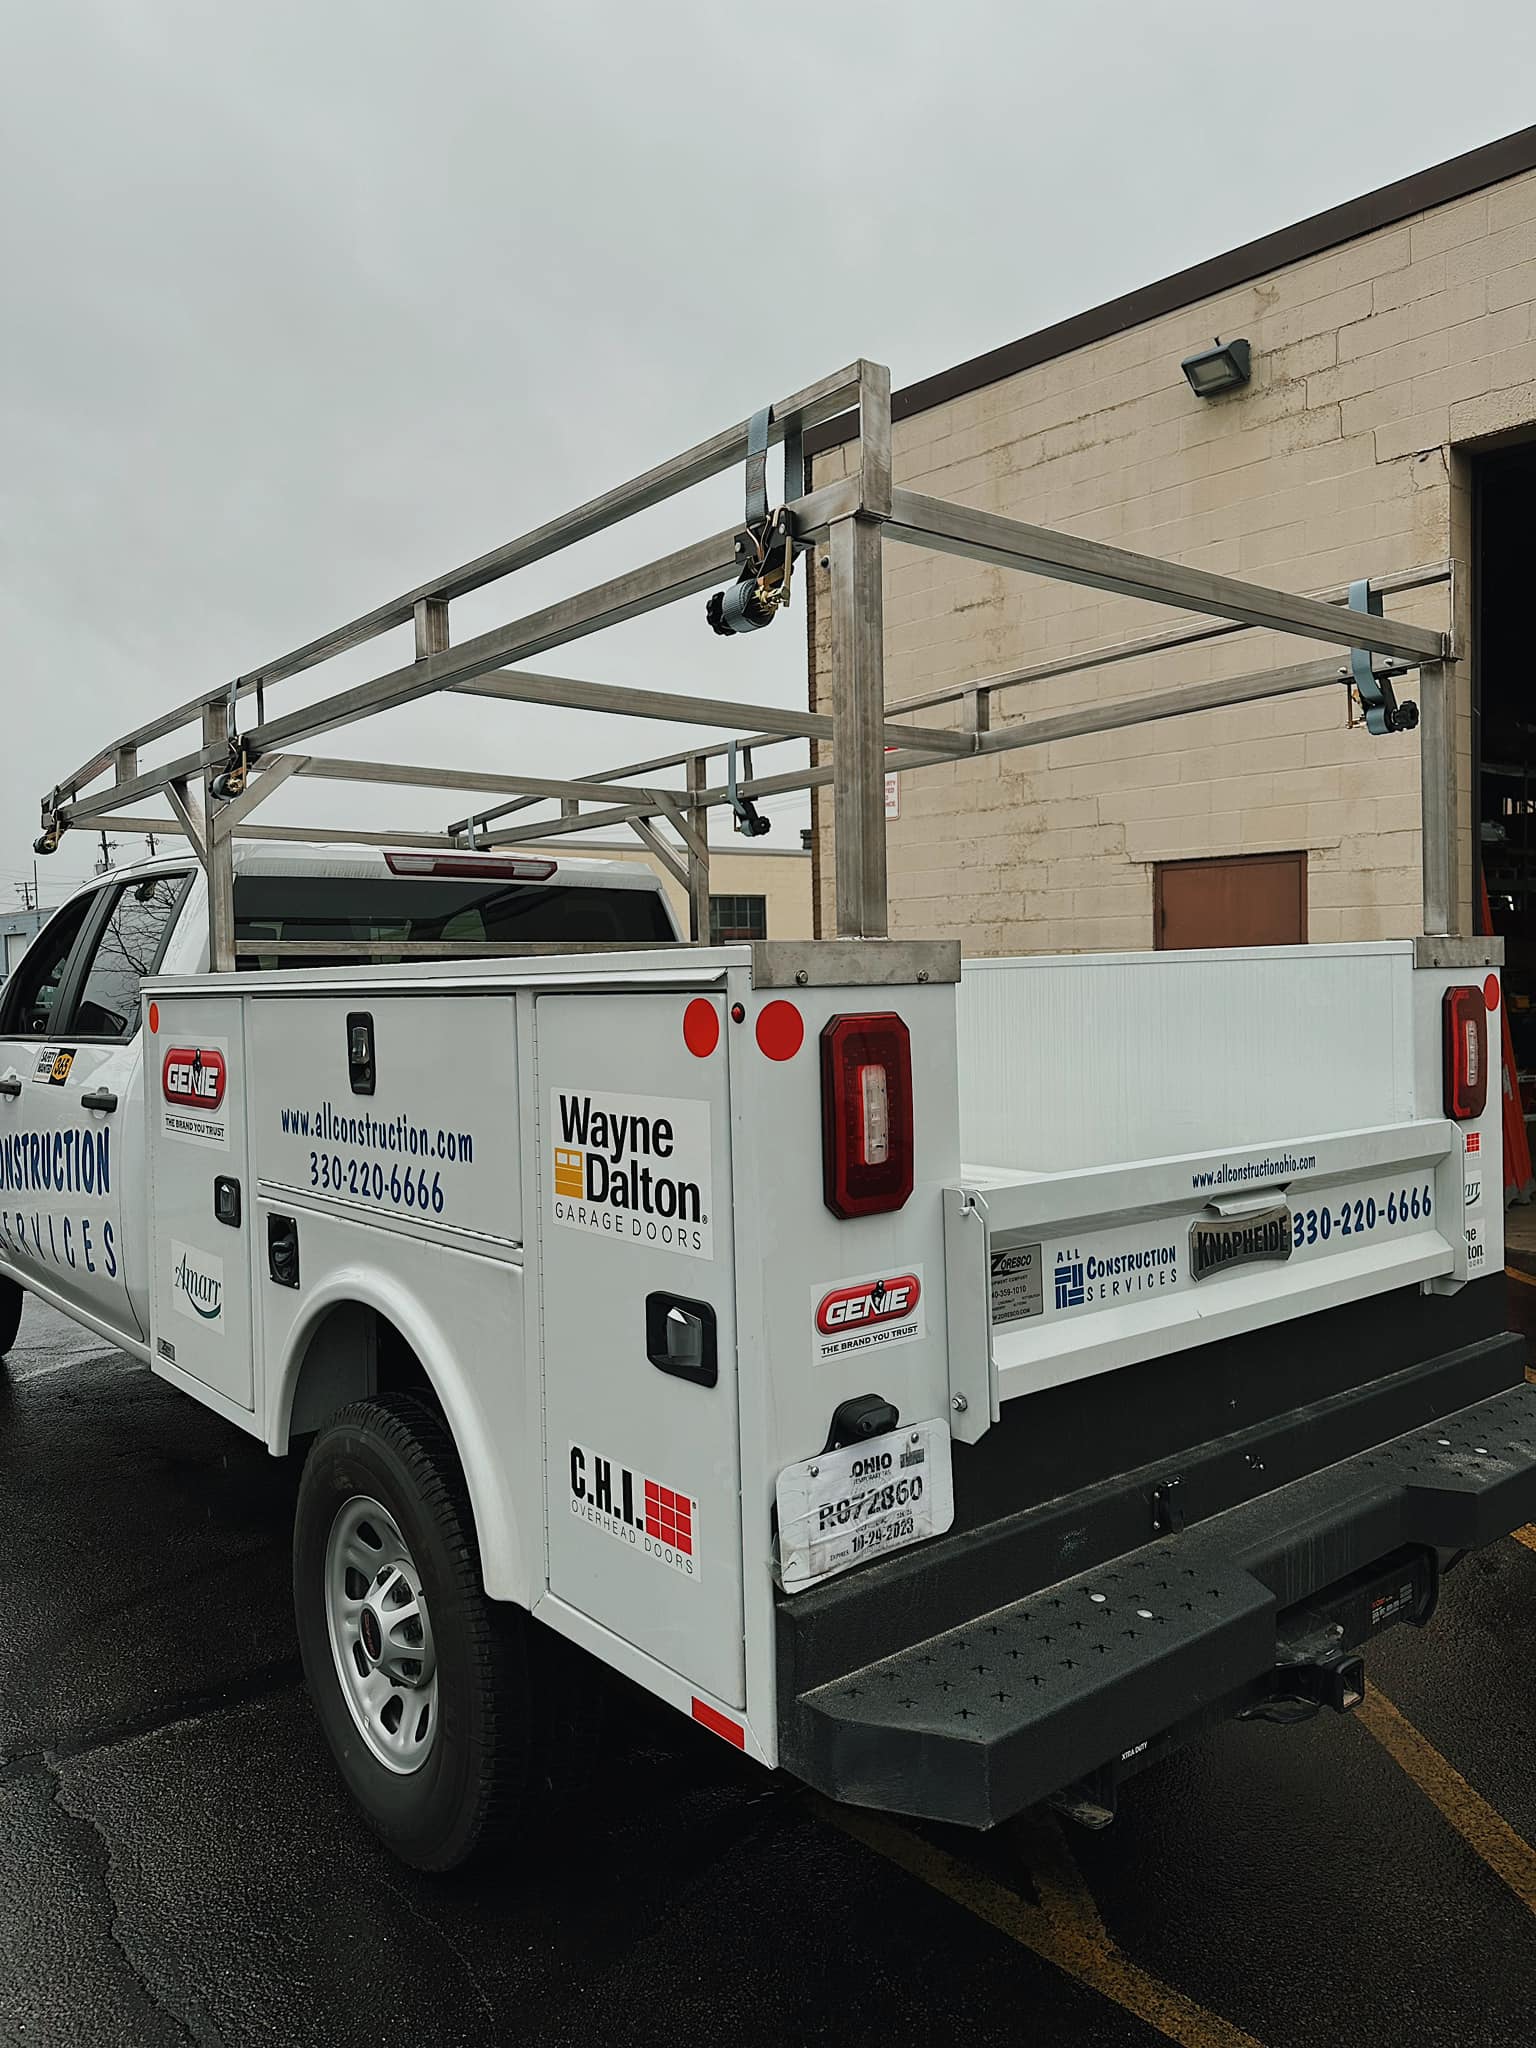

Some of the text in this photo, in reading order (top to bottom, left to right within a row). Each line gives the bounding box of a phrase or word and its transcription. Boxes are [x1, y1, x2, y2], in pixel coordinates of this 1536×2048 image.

[167, 1063, 219, 1097] GENIE
[165, 1117, 225, 1137] THE BRAND YOU TRUST
[281, 1102, 473, 1163] www.allconstruction.com
[559, 1094, 674, 1164] Wayne
[310, 1152, 444, 1213] 330-220-6666
[586, 1152, 701, 1223] Dalton
[1192, 1154, 1316, 1189] www.allconstructionohio.com
[555, 1202, 701, 1250] GARAGE DOORS
[1293, 1185, 1432, 1247] 330-220-6666
[991, 1253, 1032, 1276] ZORESCO
[1056, 1248, 1080, 1263] ALL
[1086, 1245, 1176, 1280] CONSTRUCTION
[1196, 1215, 1290, 1271] KNAPHEIDE
[175, 1252, 222, 1305] Amarr
[1086, 1268, 1177, 1301] SERVICES
[826, 1286, 910, 1325] GENIE
[821, 1325, 918, 1354] THE BRAND YOU TRUST
[851, 1453, 893, 1477] OHIO
[571, 1446, 644, 1531] C.H.I.
[571, 1499, 693, 1574] OVERHEAD DOORS
